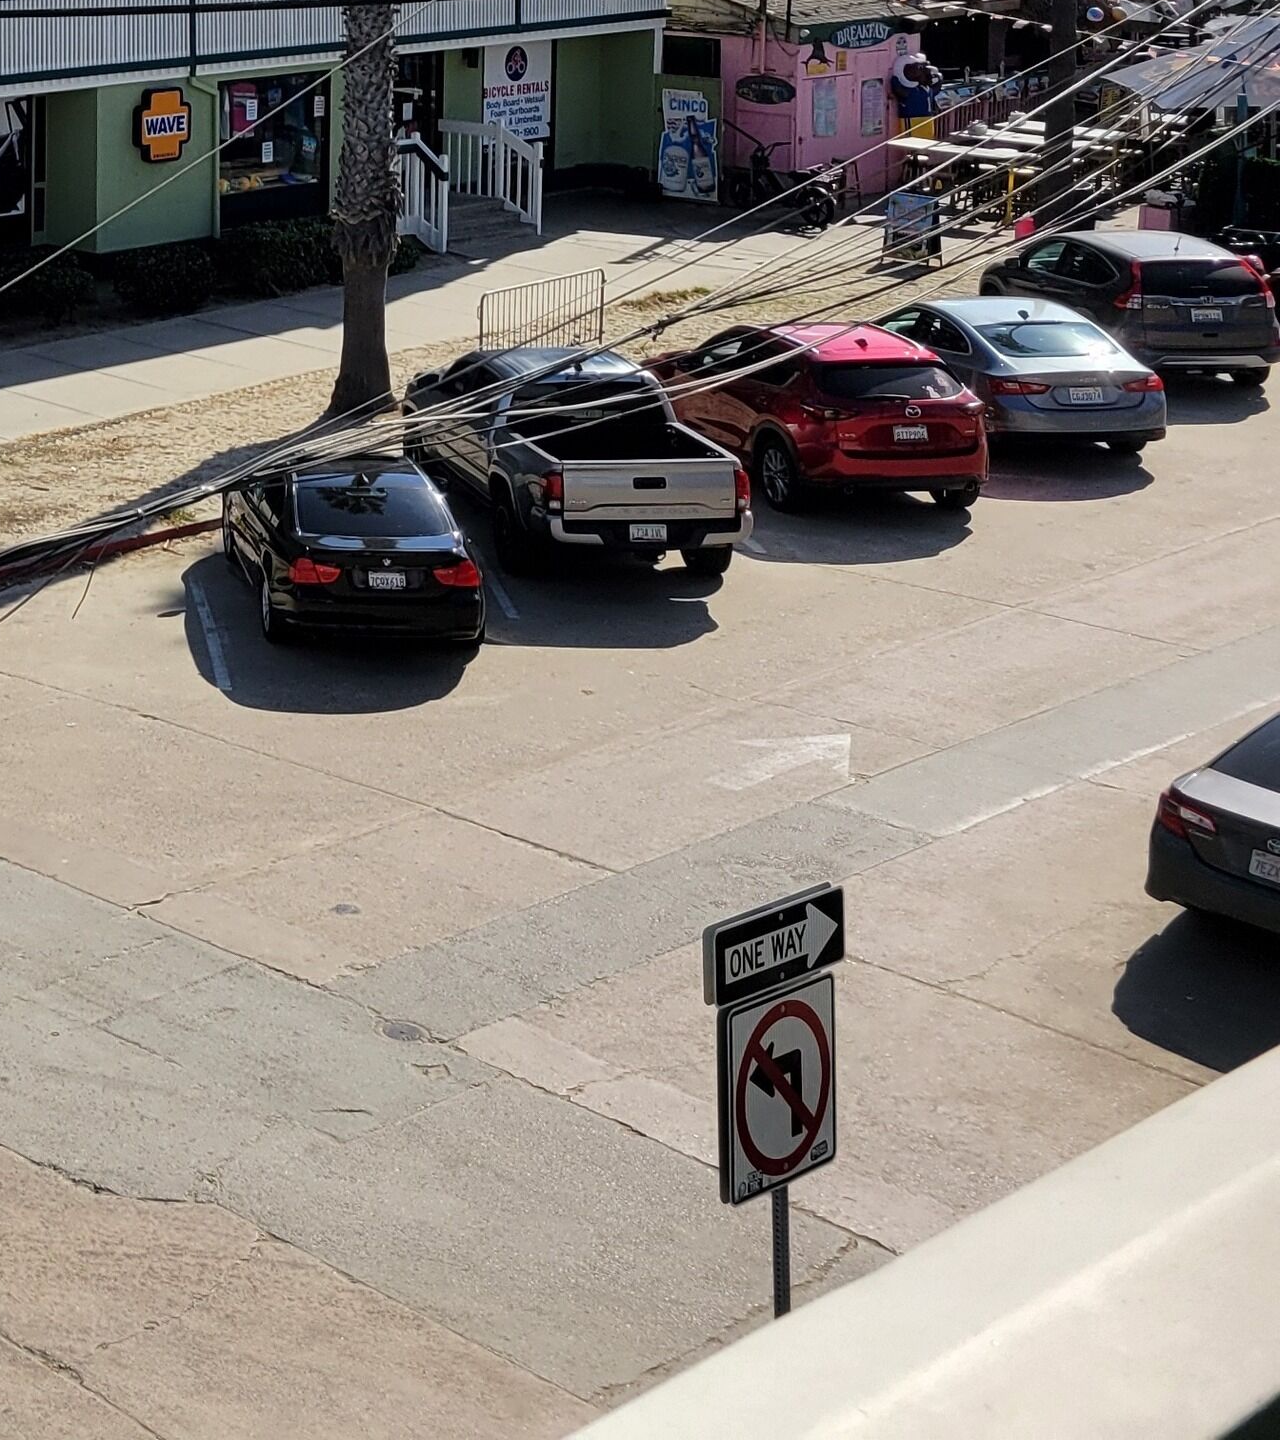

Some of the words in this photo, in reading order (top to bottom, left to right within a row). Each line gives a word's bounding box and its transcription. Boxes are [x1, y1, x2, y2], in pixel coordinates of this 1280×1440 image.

[837, 22, 891, 45] BREAKFAST
[483, 85, 515, 99] BICYCLE
[517, 80, 549, 95] RENTALS
[670, 99, 706, 112] CINCO
[145, 115, 185, 135] WAVE
[730, 939, 765, 978] ONE
[771, 923, 806, 962] WAY
